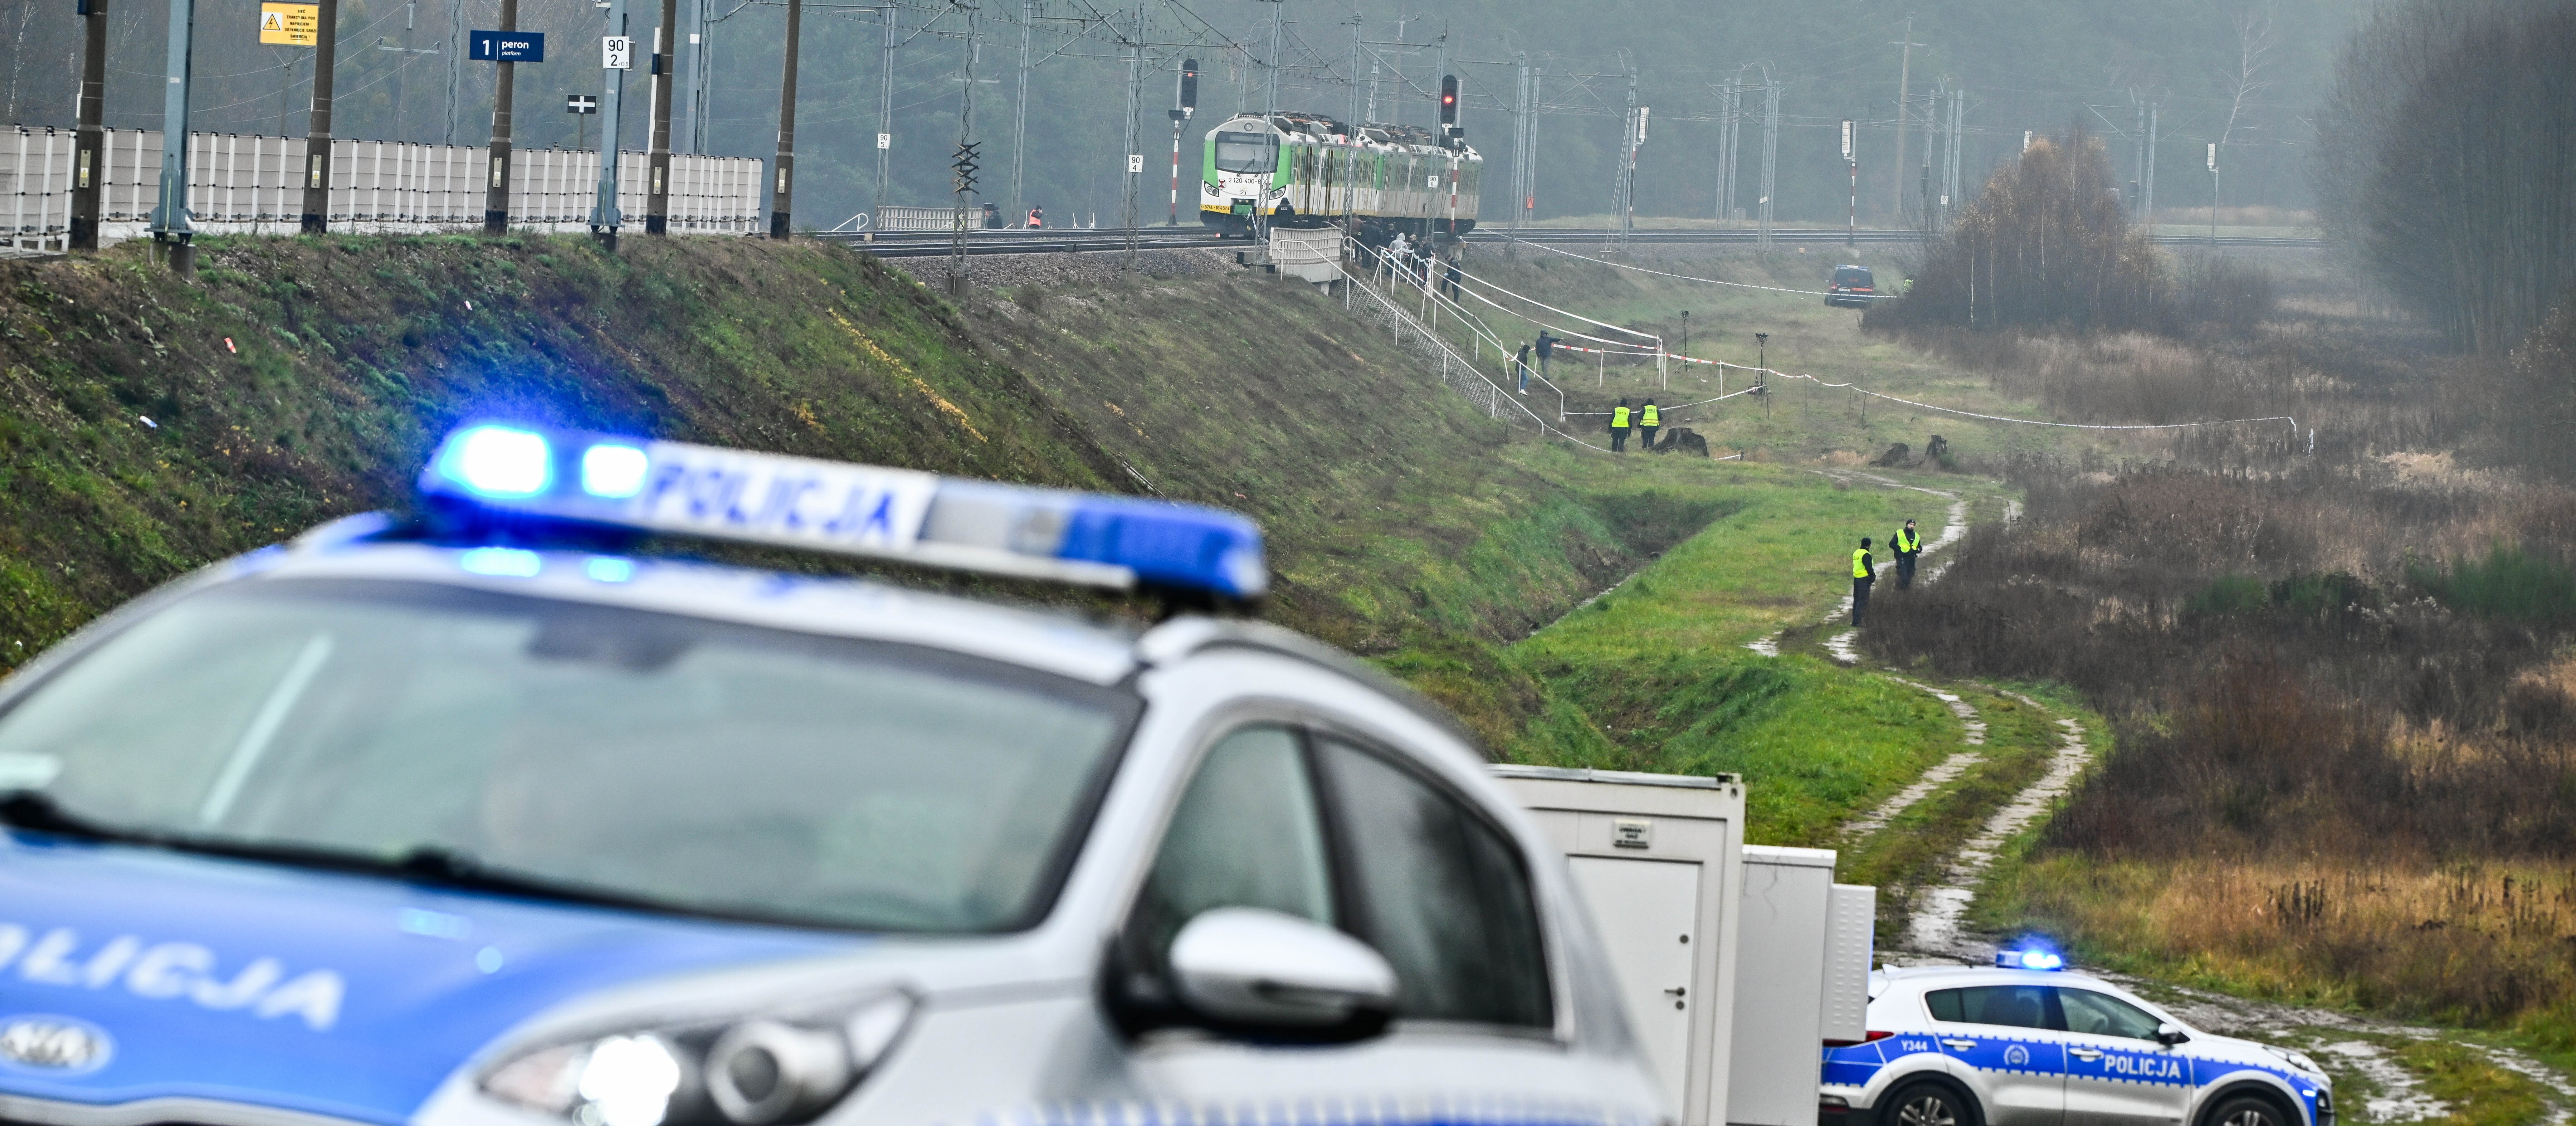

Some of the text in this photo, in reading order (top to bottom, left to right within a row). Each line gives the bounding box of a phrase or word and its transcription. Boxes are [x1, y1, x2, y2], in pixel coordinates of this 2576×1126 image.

[482, 39, 490, 56] 1
[502, 41, 529, 50] peron
[608, 39, 624, 51] 90
[611, 54, 617, 66] 2
[1901, 1040, 1928, 1051] Y344
[2104, 1055, 2181, 1079] POLICJA
